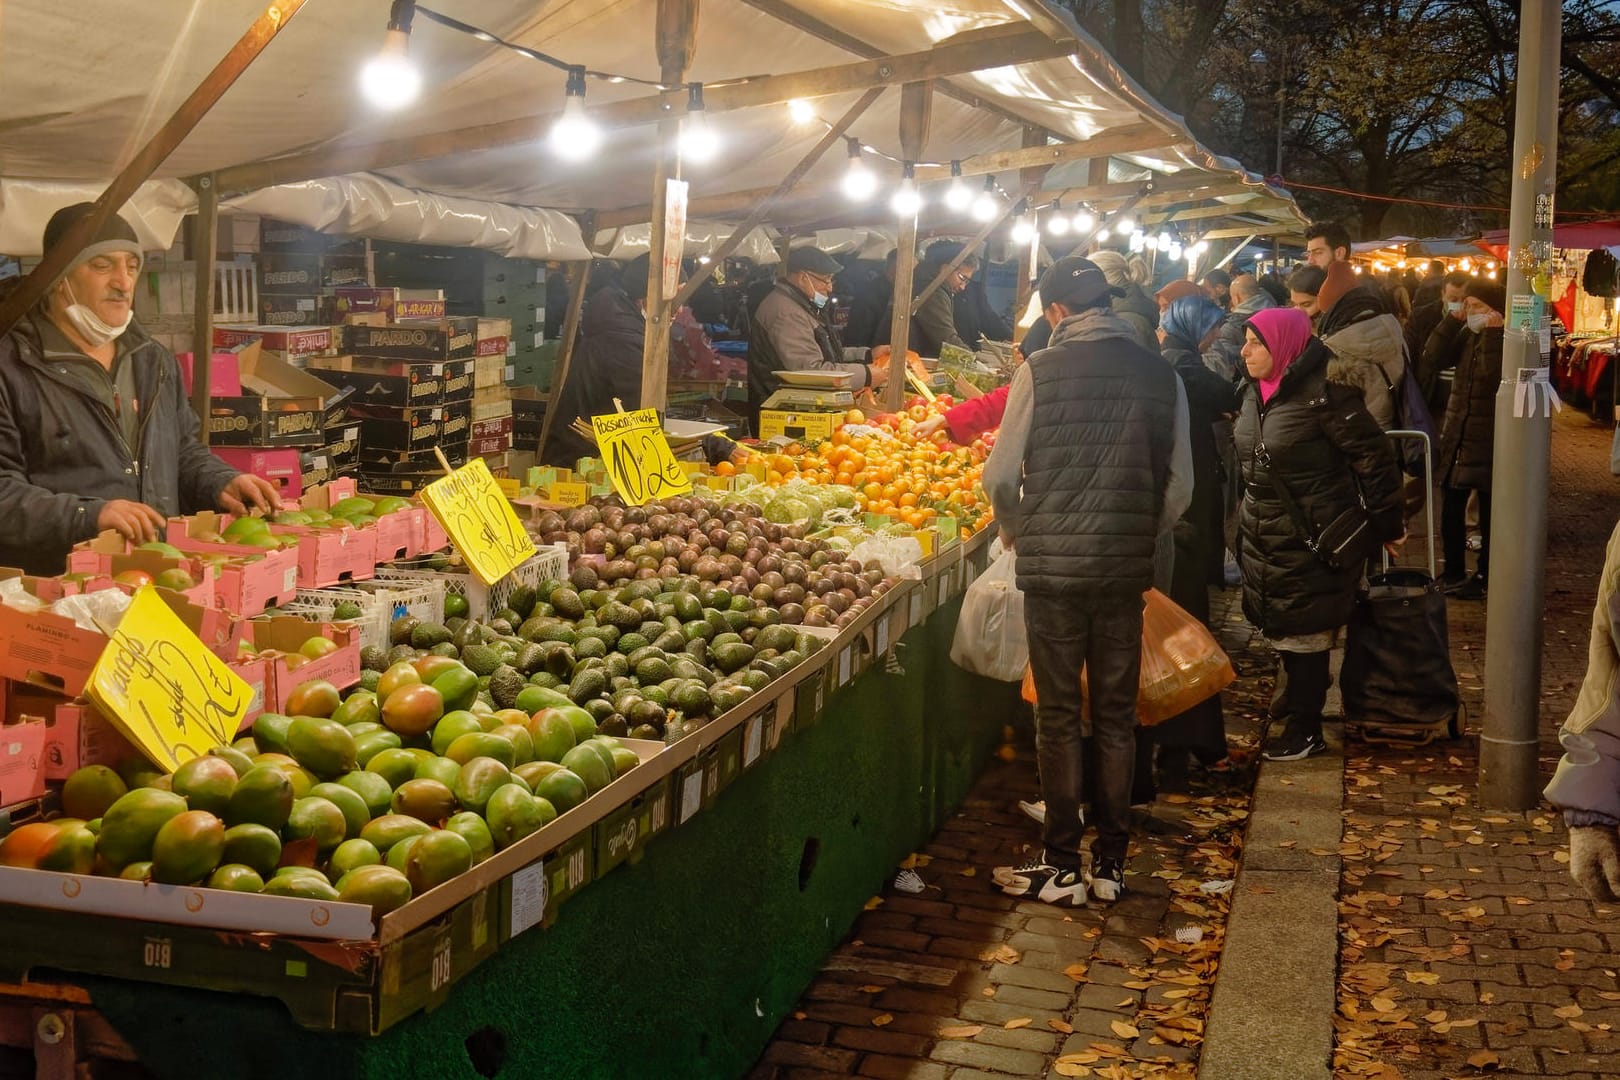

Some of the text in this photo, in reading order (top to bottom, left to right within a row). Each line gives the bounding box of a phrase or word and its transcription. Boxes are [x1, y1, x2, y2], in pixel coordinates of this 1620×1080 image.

[370, 330, 427, 347] PARDO
[411, 380, 439, 398] PARDO
[445, 374, 470, 394] PARDO
[278, 411, 314, 435] PARDO
[412, 422, 437, 441] PARDO
[612, 438, 643, 504] 10
